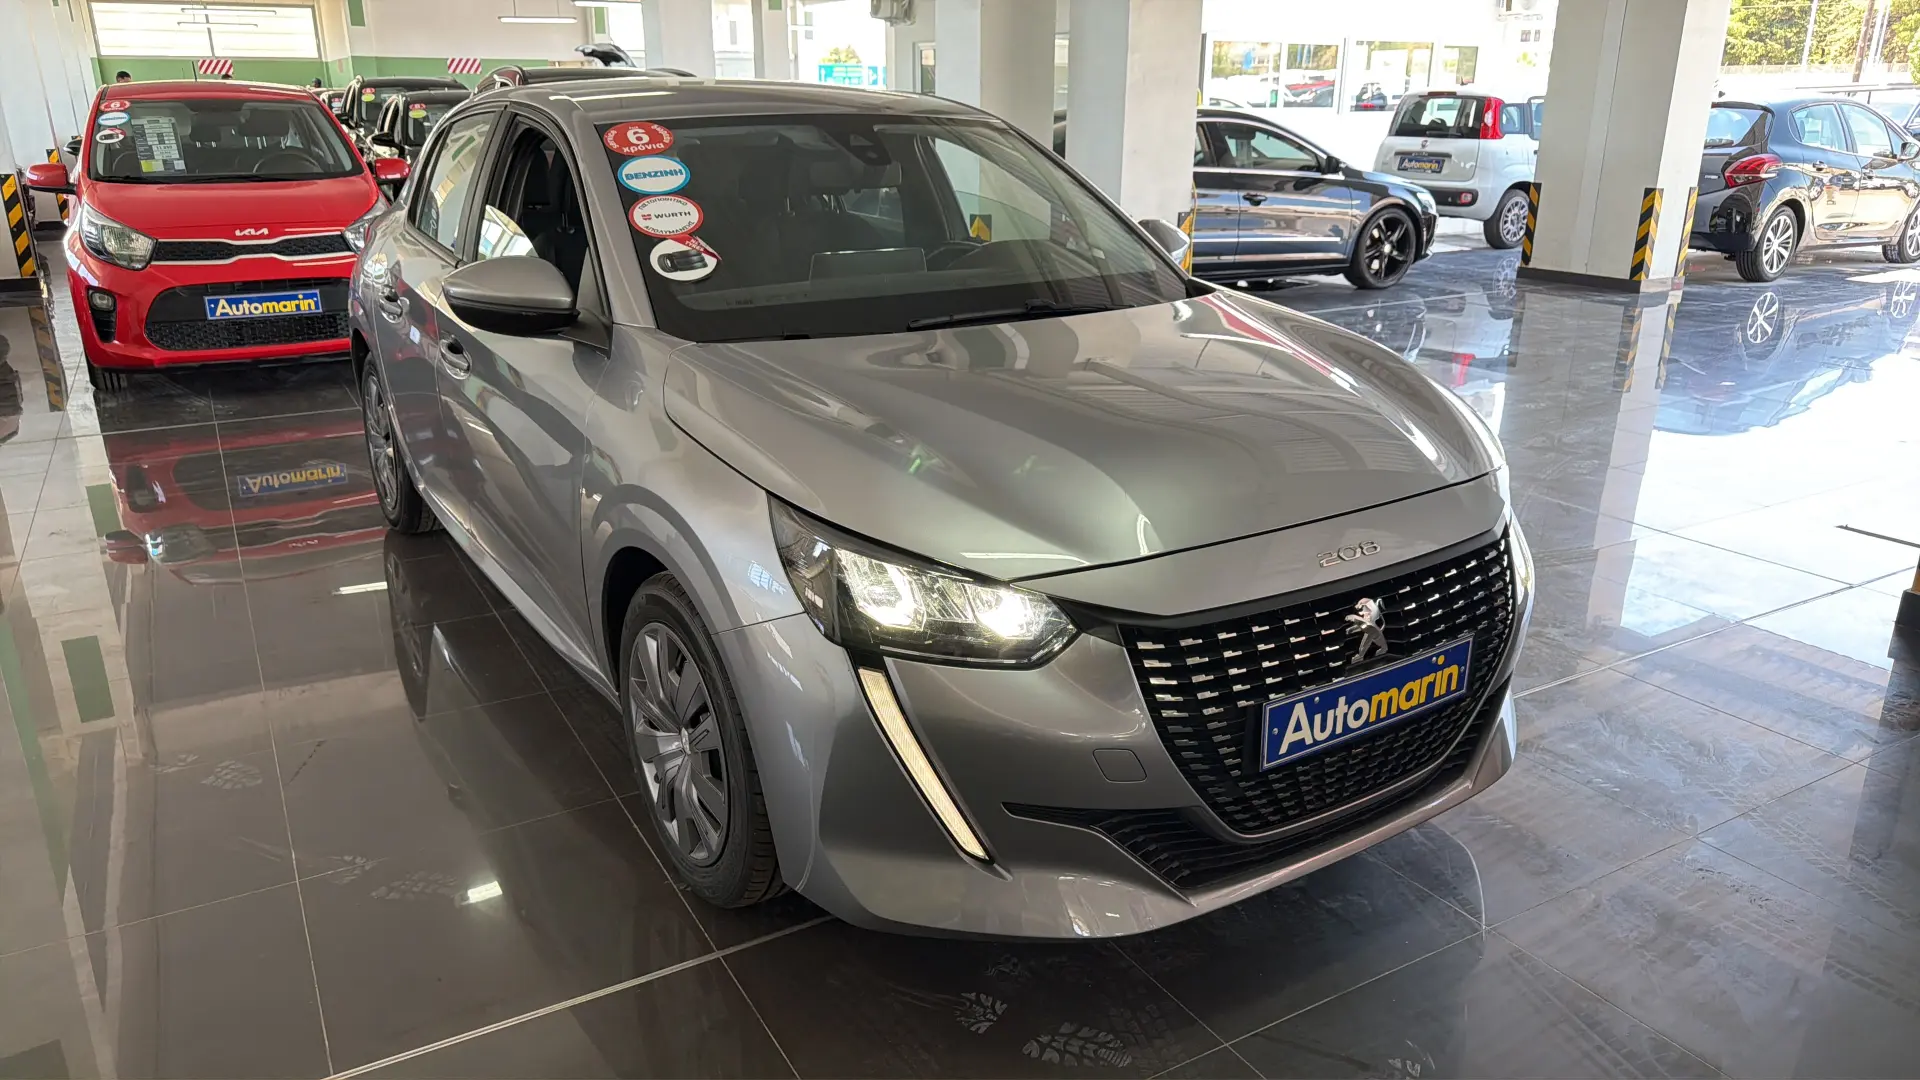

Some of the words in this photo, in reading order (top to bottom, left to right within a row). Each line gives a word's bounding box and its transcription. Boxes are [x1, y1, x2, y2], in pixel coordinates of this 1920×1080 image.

[622, 142, 665, 153] χρόνια
[626, 128, 650, 145] 6
[215, 294, 316, 317] Automarin
[1317, 540, 1381, 567] 208
[1278, 655, 1459, 755] Automarin
